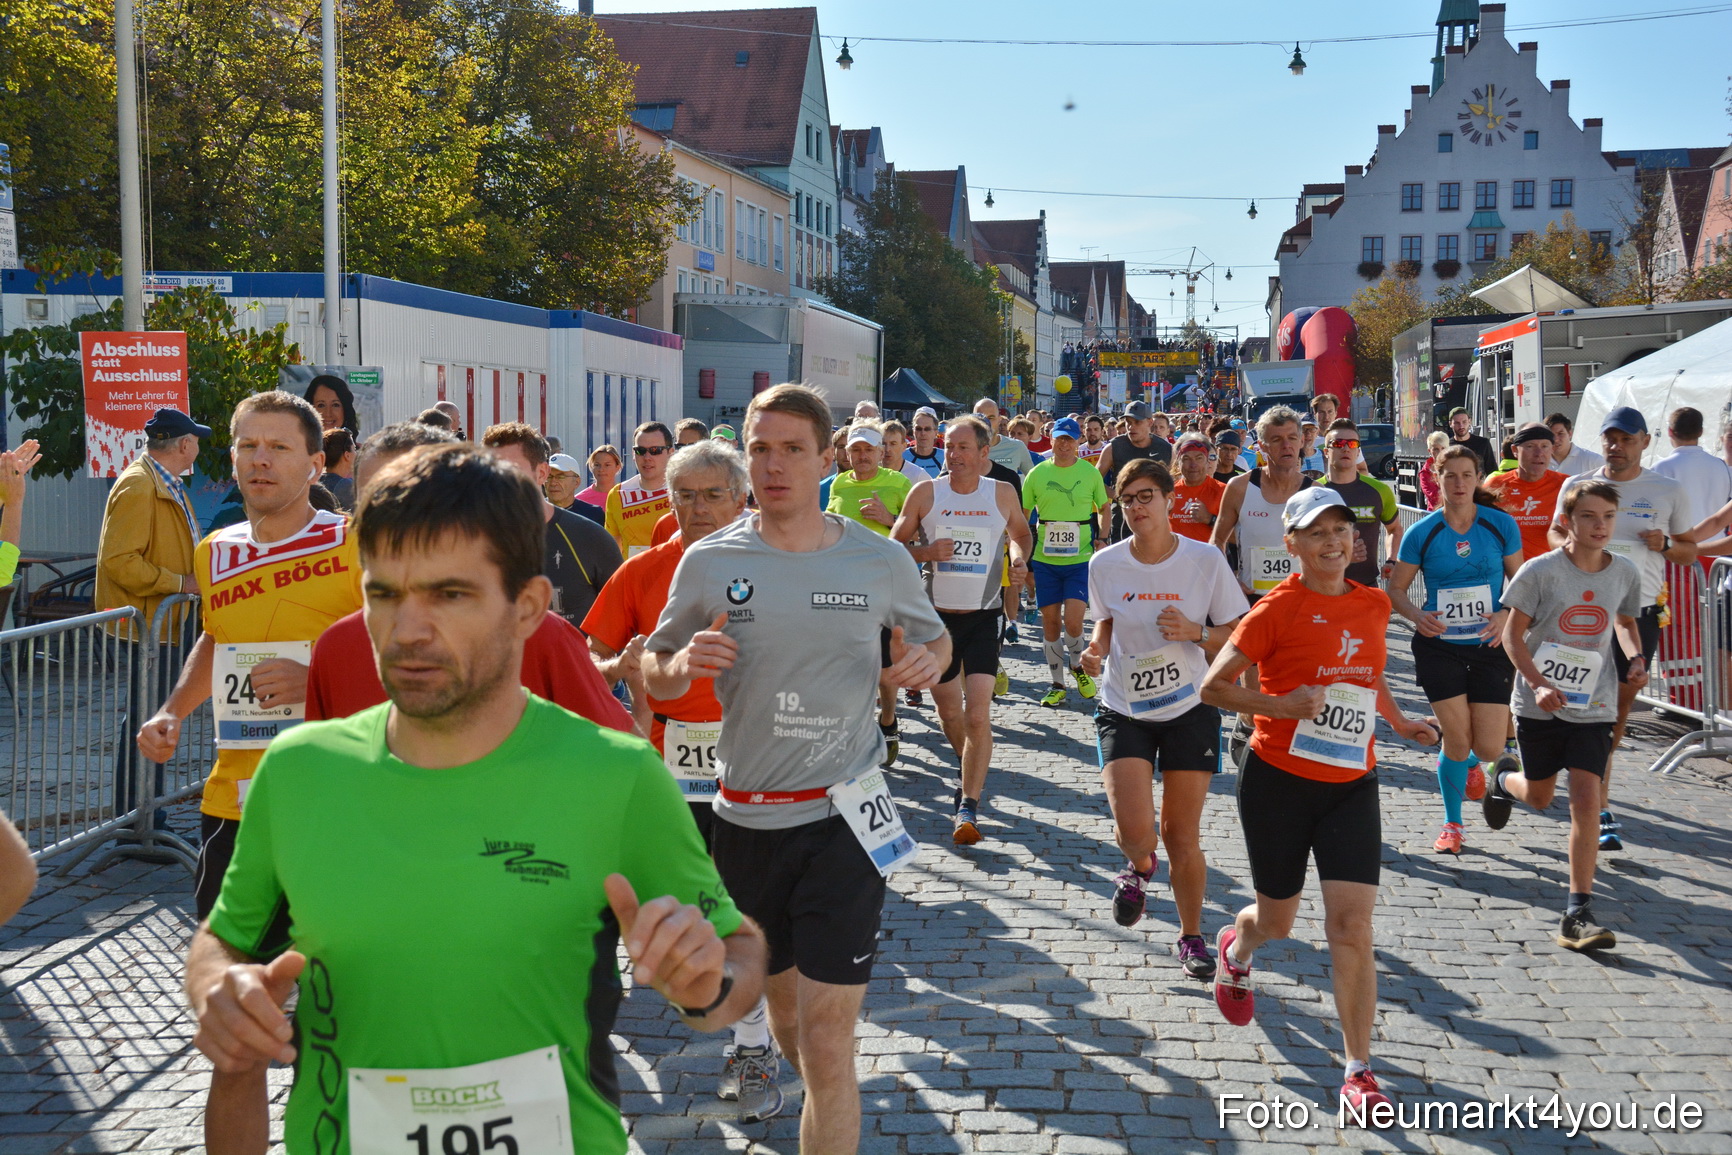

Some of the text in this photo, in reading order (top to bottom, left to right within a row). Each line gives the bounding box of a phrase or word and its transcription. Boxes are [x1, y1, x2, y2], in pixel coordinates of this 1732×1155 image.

[91, 341, 180, 357] Abschluss
[91, 358, 121, 368] statt
[1130, 355, 1166, 364] START
[92, 368, 182, 383] Ausschluss!
[1261, 377, 1294, 385] BOCK
[109, 391, 179, 400] Mehr Lehrer für
[105, 402, 179, 411] kleinere Klassen.
[622, 499, 671, 521] MAX BÖ
[1248, 510, 1269, 518] LGO
[1349, 506, 1377, 519] CK
[1049, 531, 1075, 543] 2138
[953, 540, 983, 557] 273
[950, 564, 973, 572] Roland
[1262, 559, 1291, 574] 349
[210, 556, 349, 611] MAX BÖGL
[811, 592, 869, 607] BOCK
[1138, 593, 1184, 601] KLEBL
[727, 609, 755, 618] PARTL
[1446, 601, 1485, 619] 2119
[1458, 626, 1477, 635] Sonja
[1131, 662, 1181, 692] 2275
[1316, 665, 1374, 679] funrunners
[1541, 660, 1591, 684] 2047
[1148, 693, 1179, 710] Nadine
[1330, 688, 1360, 702] BOCK
[775, 692, 806, 713] 19.
[231, 709, 282, 717] PARTL Neumarkt
[774, 713, 841, 727] Neumarkter
[1313, 703, 1366, 735] 3025
[241, 724, 278, 737] Bernd
[773, 726, 827, 740] Stadtlauf
[1315, 729, 1333, 739] PARTL
[677, 744, 716, 769] 219
[689, 782, 721, 793] Micha
[411, 1081, 502, 1107] BOCK
[406, 1115, 519, 1155] 195
